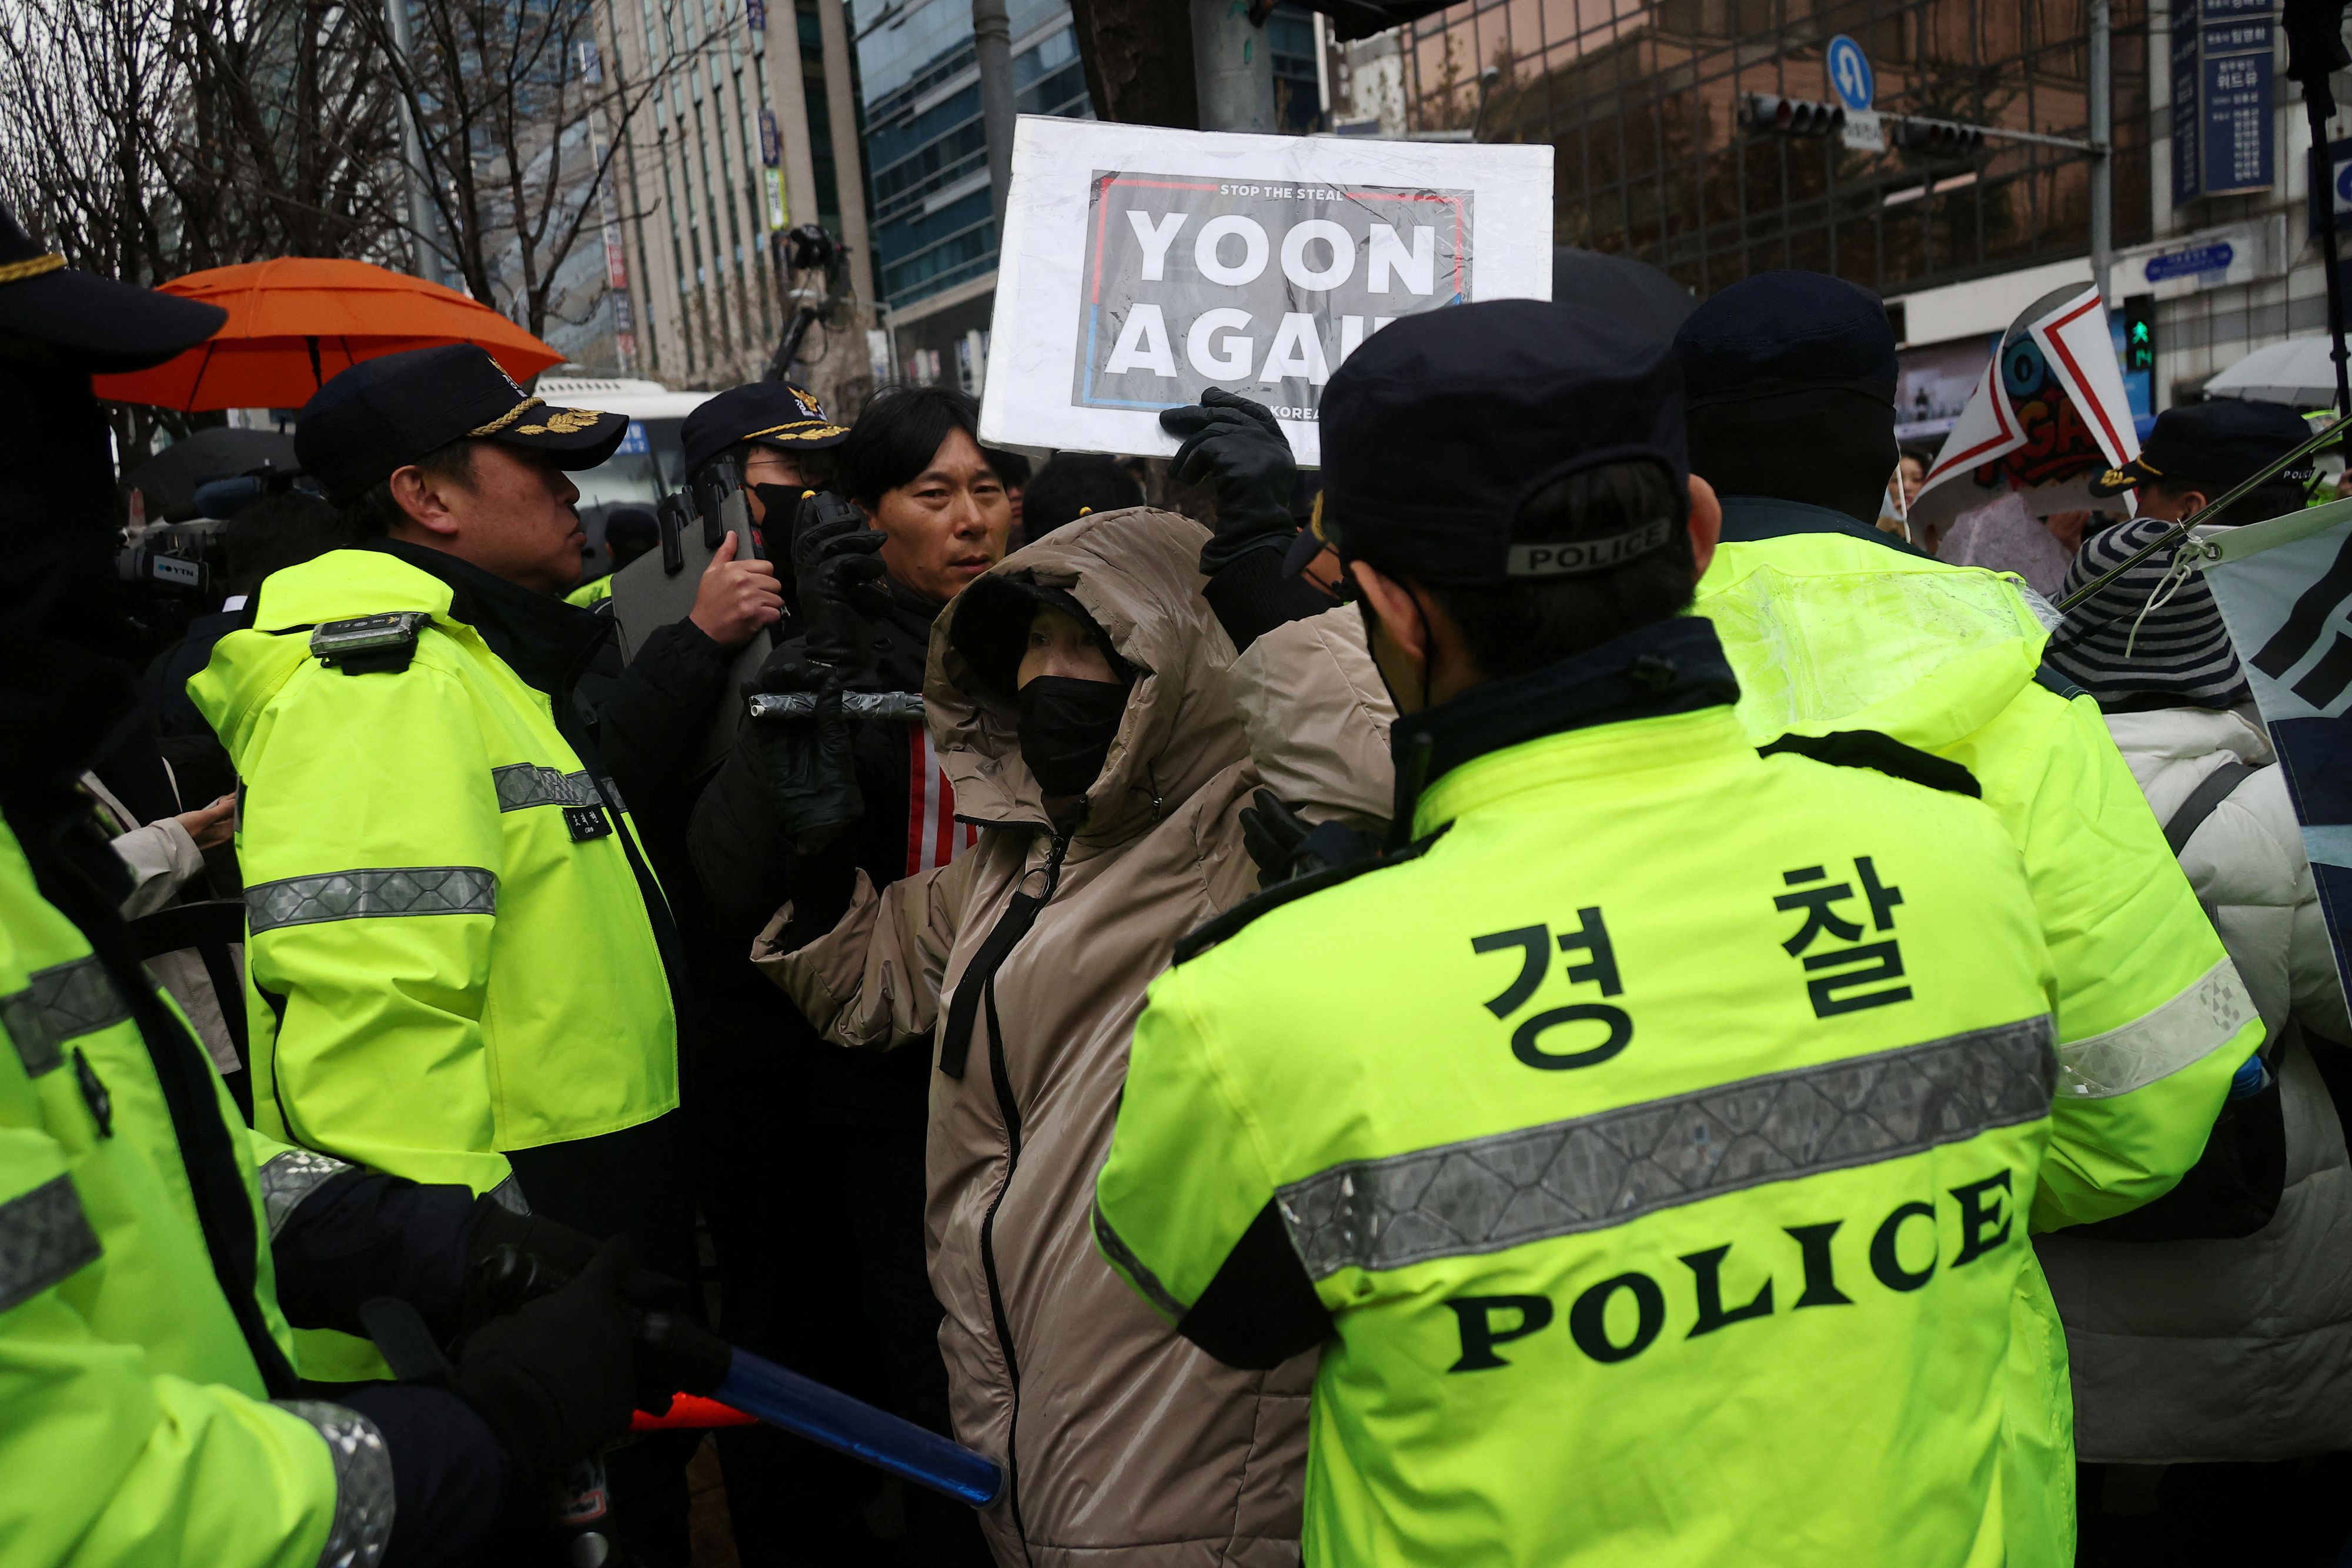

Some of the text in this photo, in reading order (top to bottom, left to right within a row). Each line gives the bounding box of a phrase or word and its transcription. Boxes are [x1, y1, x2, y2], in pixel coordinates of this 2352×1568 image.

[1221, 184, 1344, 201] STOP THE STEAL
[1125, 210, 1435, 295] YOON
[1104, 303, 1397, 386] AGAI
[173, 566, 194, 577] YTN
[1529, 524, 1662, 570] POLICE
[1439, 1169, 2013, 1373] POLICE
